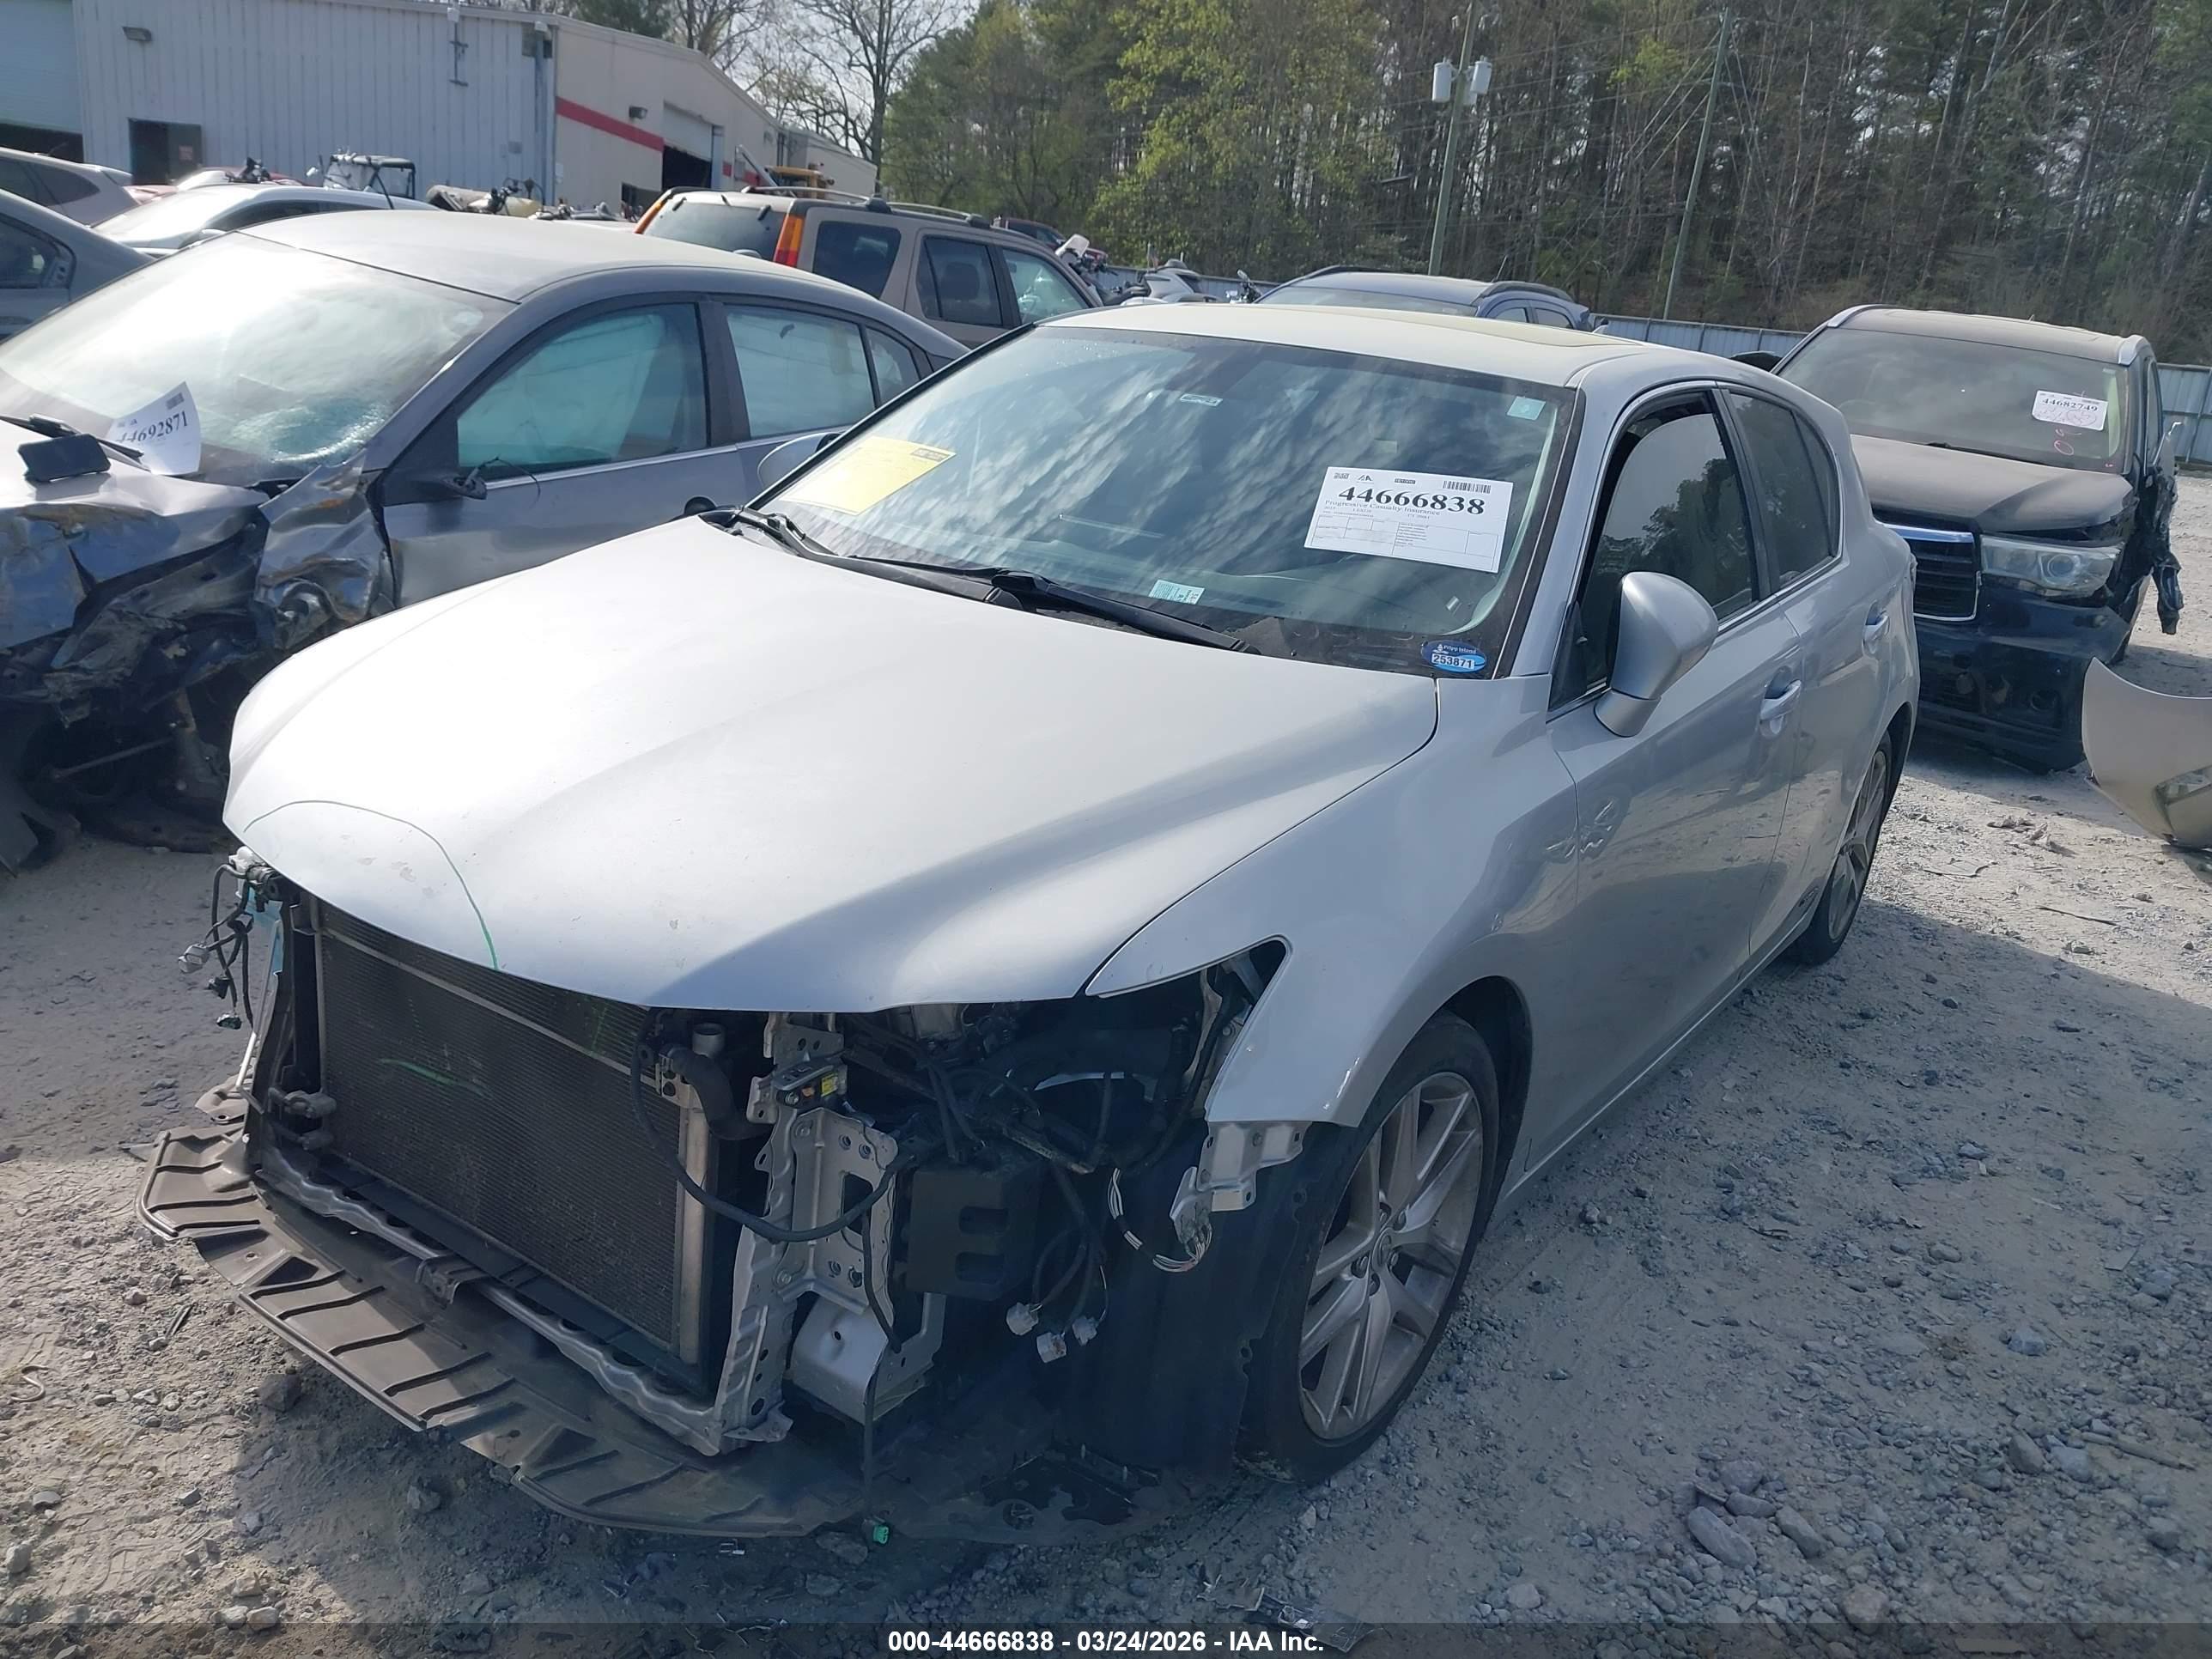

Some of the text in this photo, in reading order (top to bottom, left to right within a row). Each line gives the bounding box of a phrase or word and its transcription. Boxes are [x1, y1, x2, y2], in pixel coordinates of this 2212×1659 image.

[1325, 500, 1369, 509] Progressive
[1370, 503, 1403, 513] Casualty
[1404, 506, 1441, 516] Insurance
[1339, 486, 1486, 515] 44666838
[1433, 655, 1472, 668] 253871
